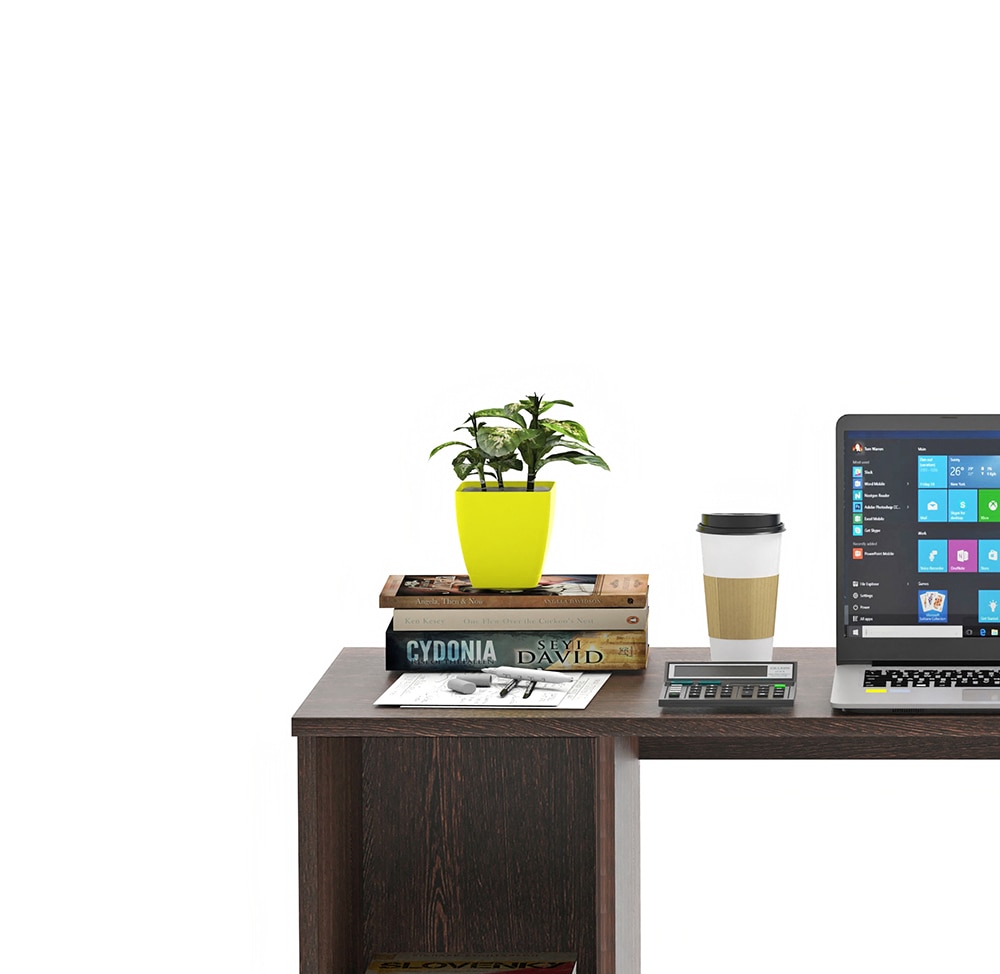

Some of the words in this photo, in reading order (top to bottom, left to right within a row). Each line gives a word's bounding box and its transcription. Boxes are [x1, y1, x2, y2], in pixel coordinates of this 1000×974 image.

[415, 597, 440, 606] Angela,
[440, 597, 460, 605] Then
[460, 597, 467, 605] &
[468, 597, 484, 605] Now
[404, 617, 420, 625] Ken
[422, 617, 445, 627] Kesey
[463, 617, 478, 625] One
[482, 617, 499, 625] Flew
[502, 617, 521, 625] Over
[523, 617, 535, 625] the
[538, 617, 575, 625] Cuckoo's
[576, 617, 594, 625] Nest
[537, 639, 581, 650] SEYI
[406, 639, 497, 662] CYDONIA
[518, 650, 604, 664] DAVID
[378, 961, 566, 969] SLOVENKY
